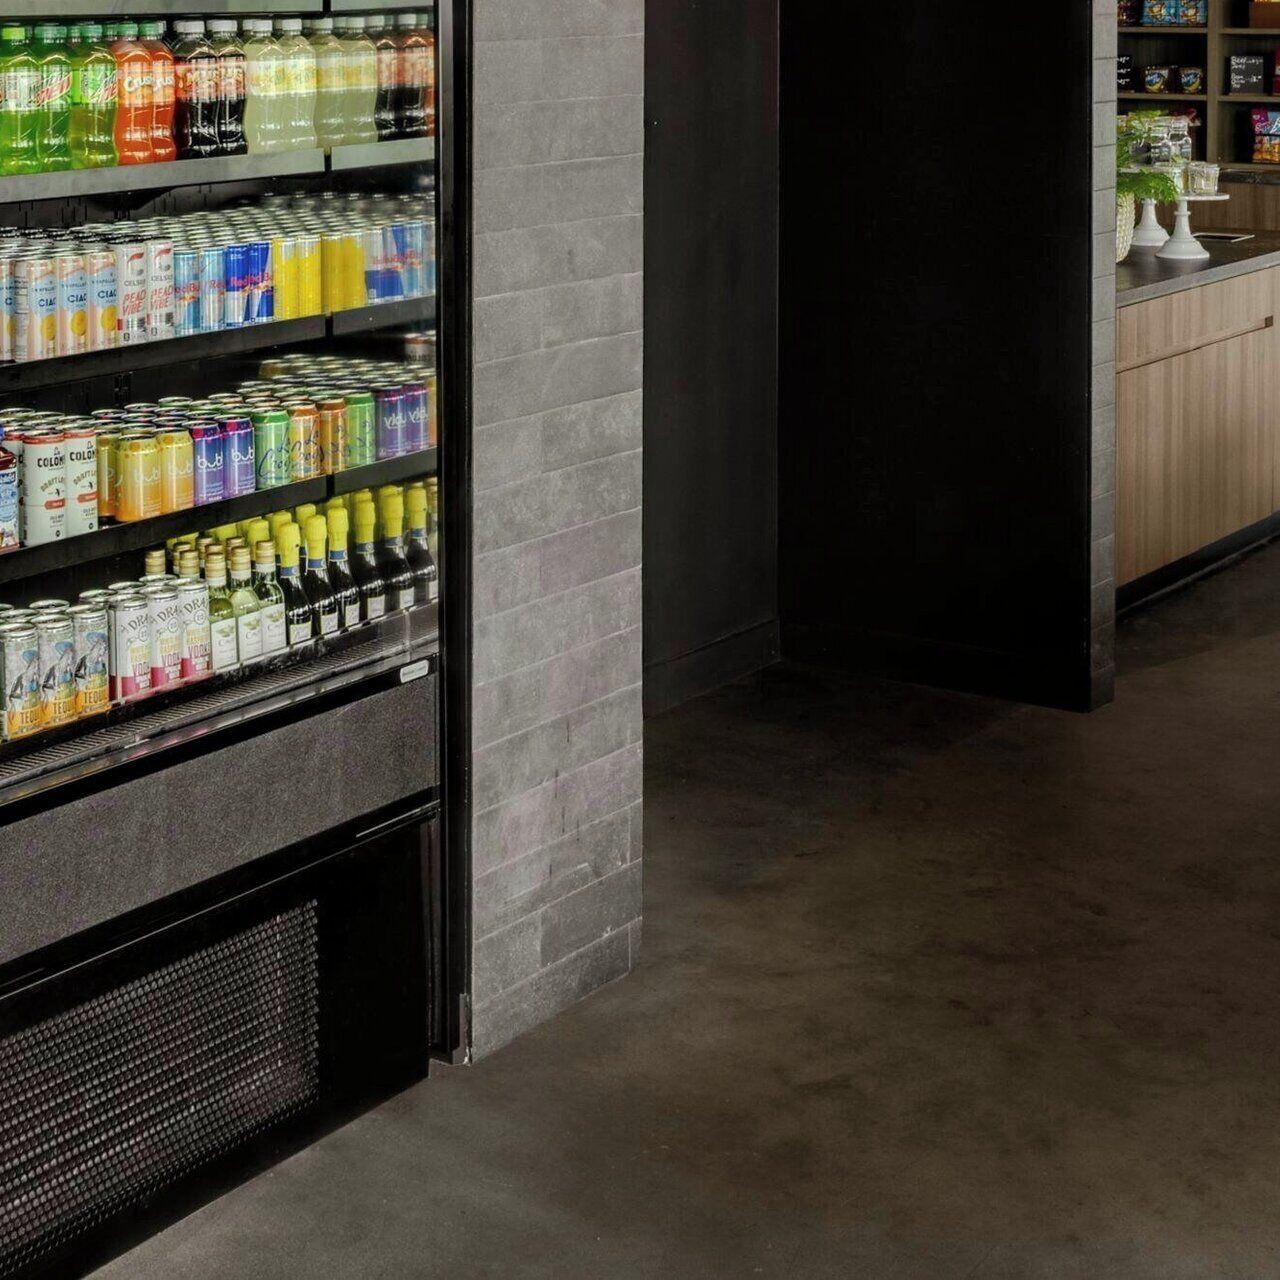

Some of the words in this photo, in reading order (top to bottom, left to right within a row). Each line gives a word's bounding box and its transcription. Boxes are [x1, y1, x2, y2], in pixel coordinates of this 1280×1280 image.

[197, 452, 224, 470] bub
[231, 448, 255, 463] bub
[157, 605, 180, 623] DRA
[183, 597, 207, 614] DRA
[128, 613, 150, 630] DRA
